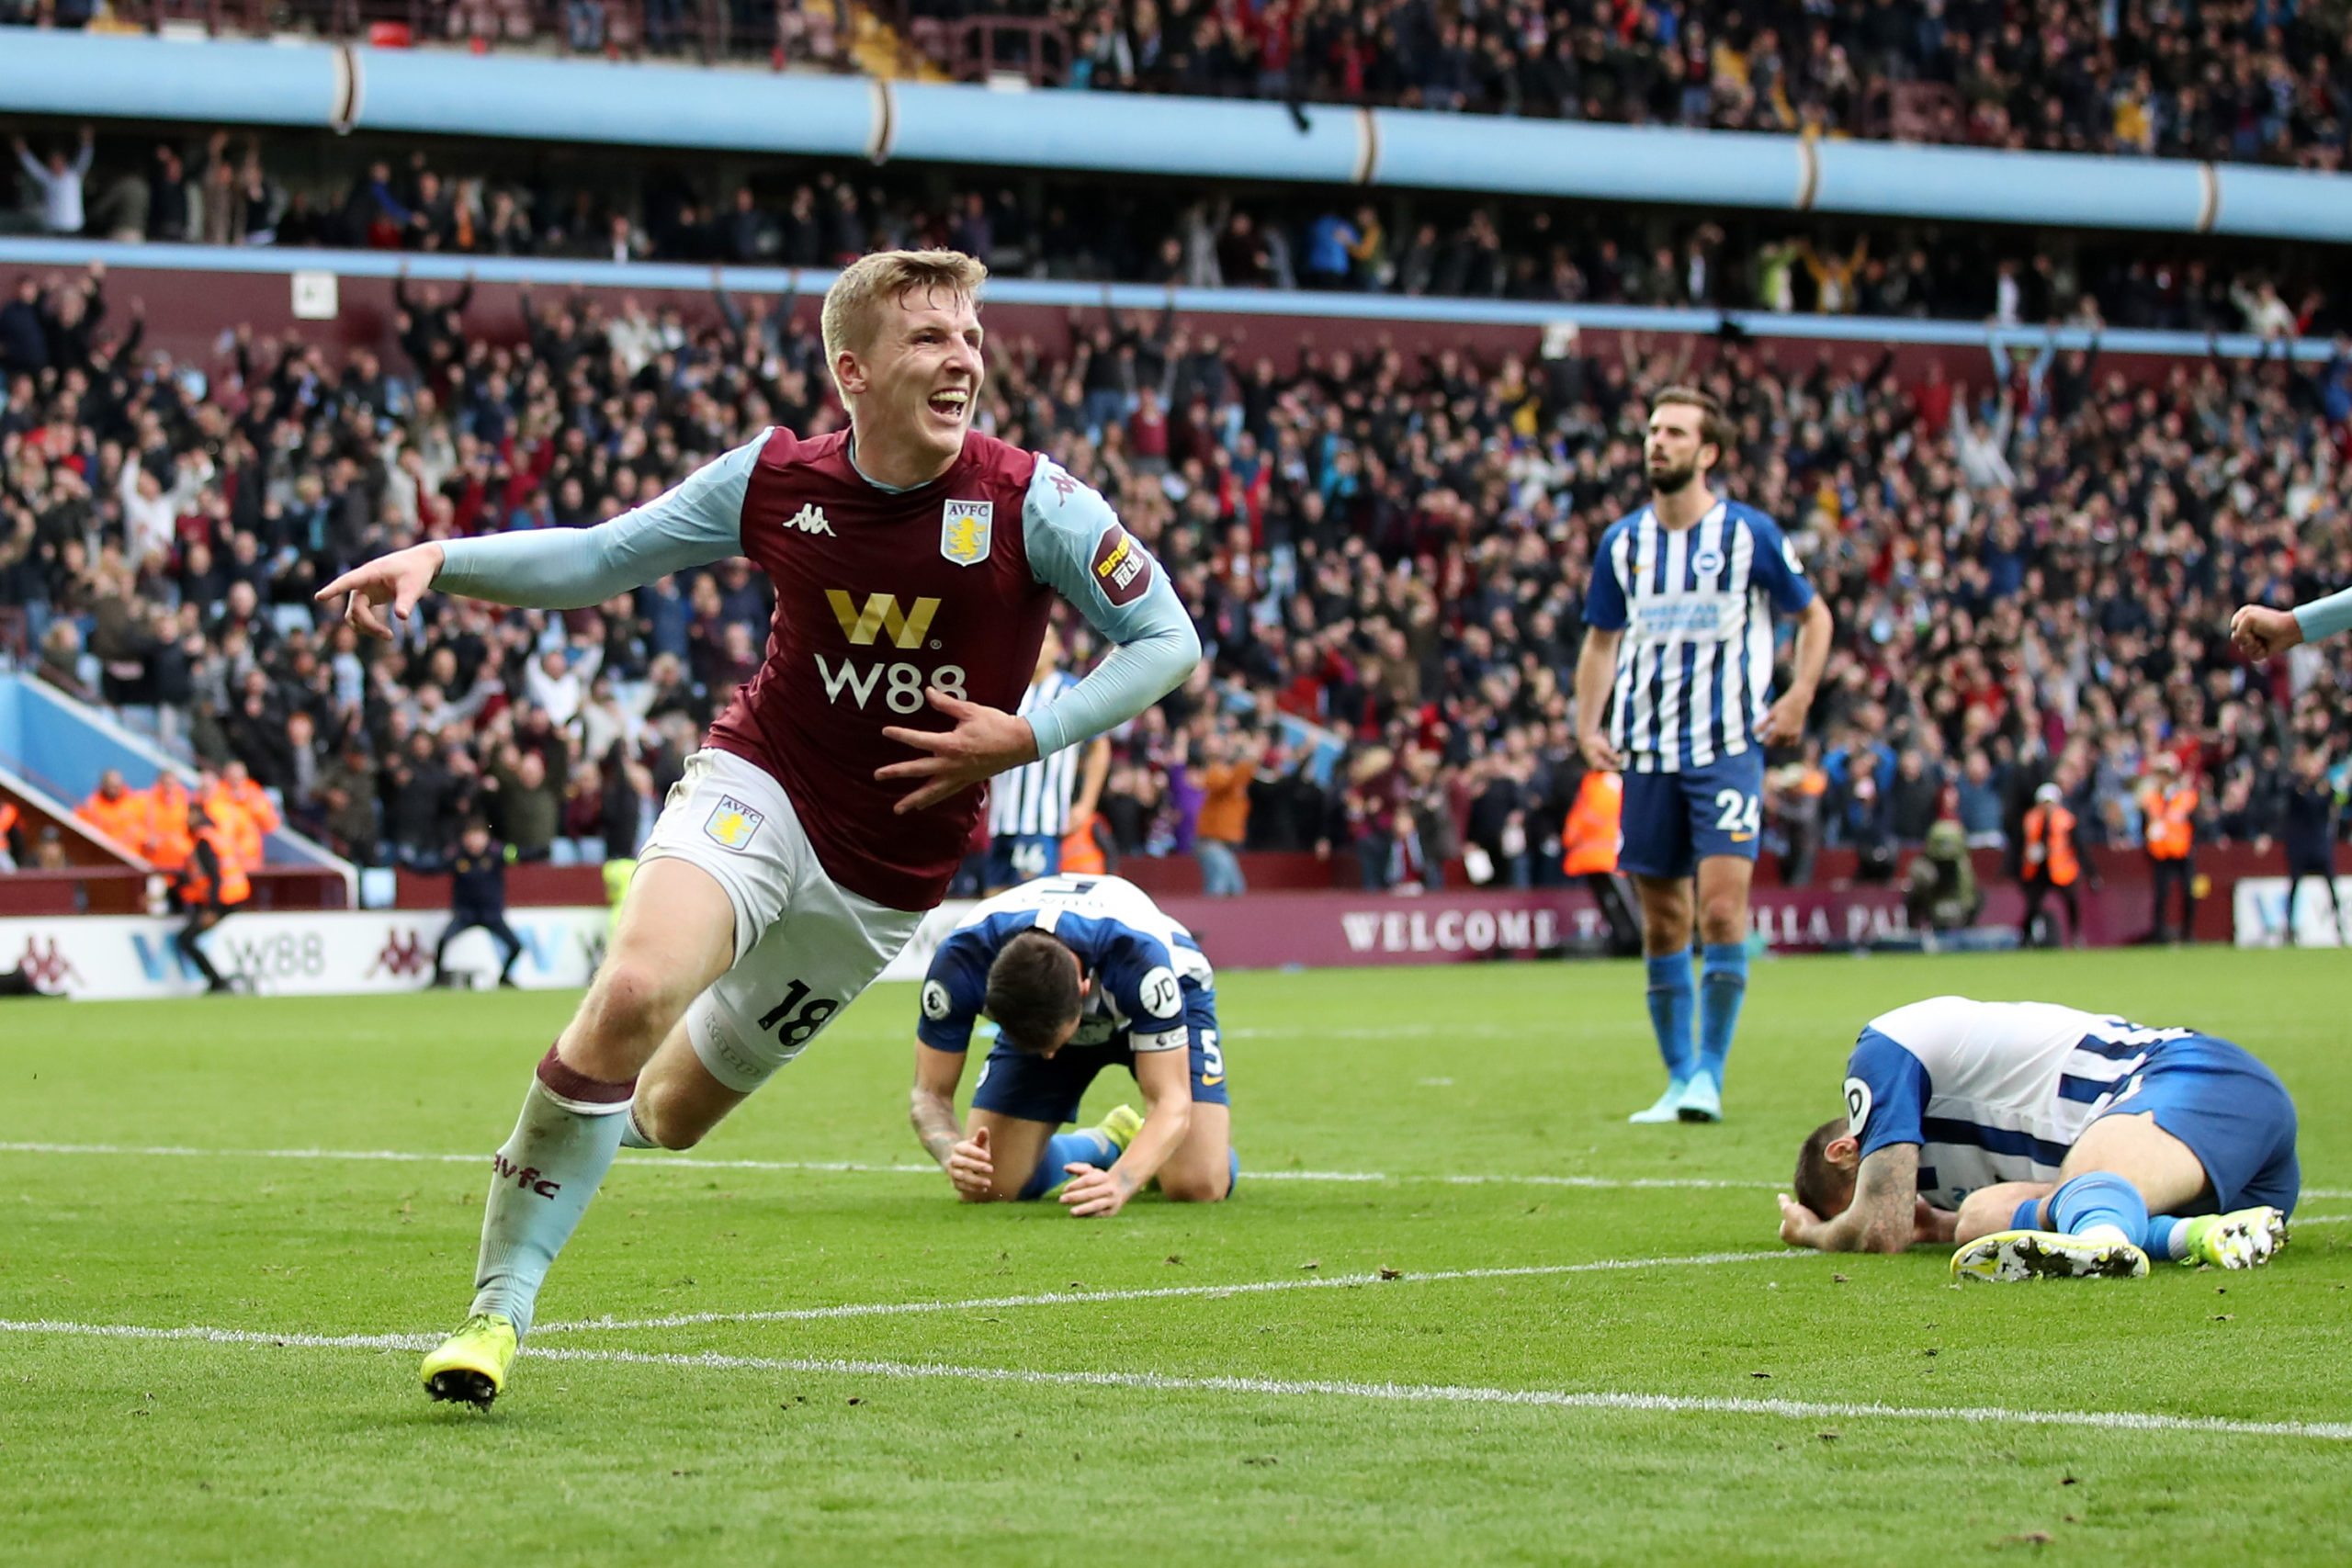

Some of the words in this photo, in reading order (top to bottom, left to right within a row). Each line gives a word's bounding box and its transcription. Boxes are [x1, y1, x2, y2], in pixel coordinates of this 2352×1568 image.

[947, 503, 989, 517] AVFC
[813, 652, 967, 715] W88
[722, 800, 760, 824] AVFC
[1715, 788, 1760, 838] 24
[1341, 909, 1560, 952] WELCOME
[226, 932, 325, 978] W88
[758, 979, 839, 1047] 18
[1154, 977, 1175, 1010] JD
[1201, 1029, 1224, 1075] 5
